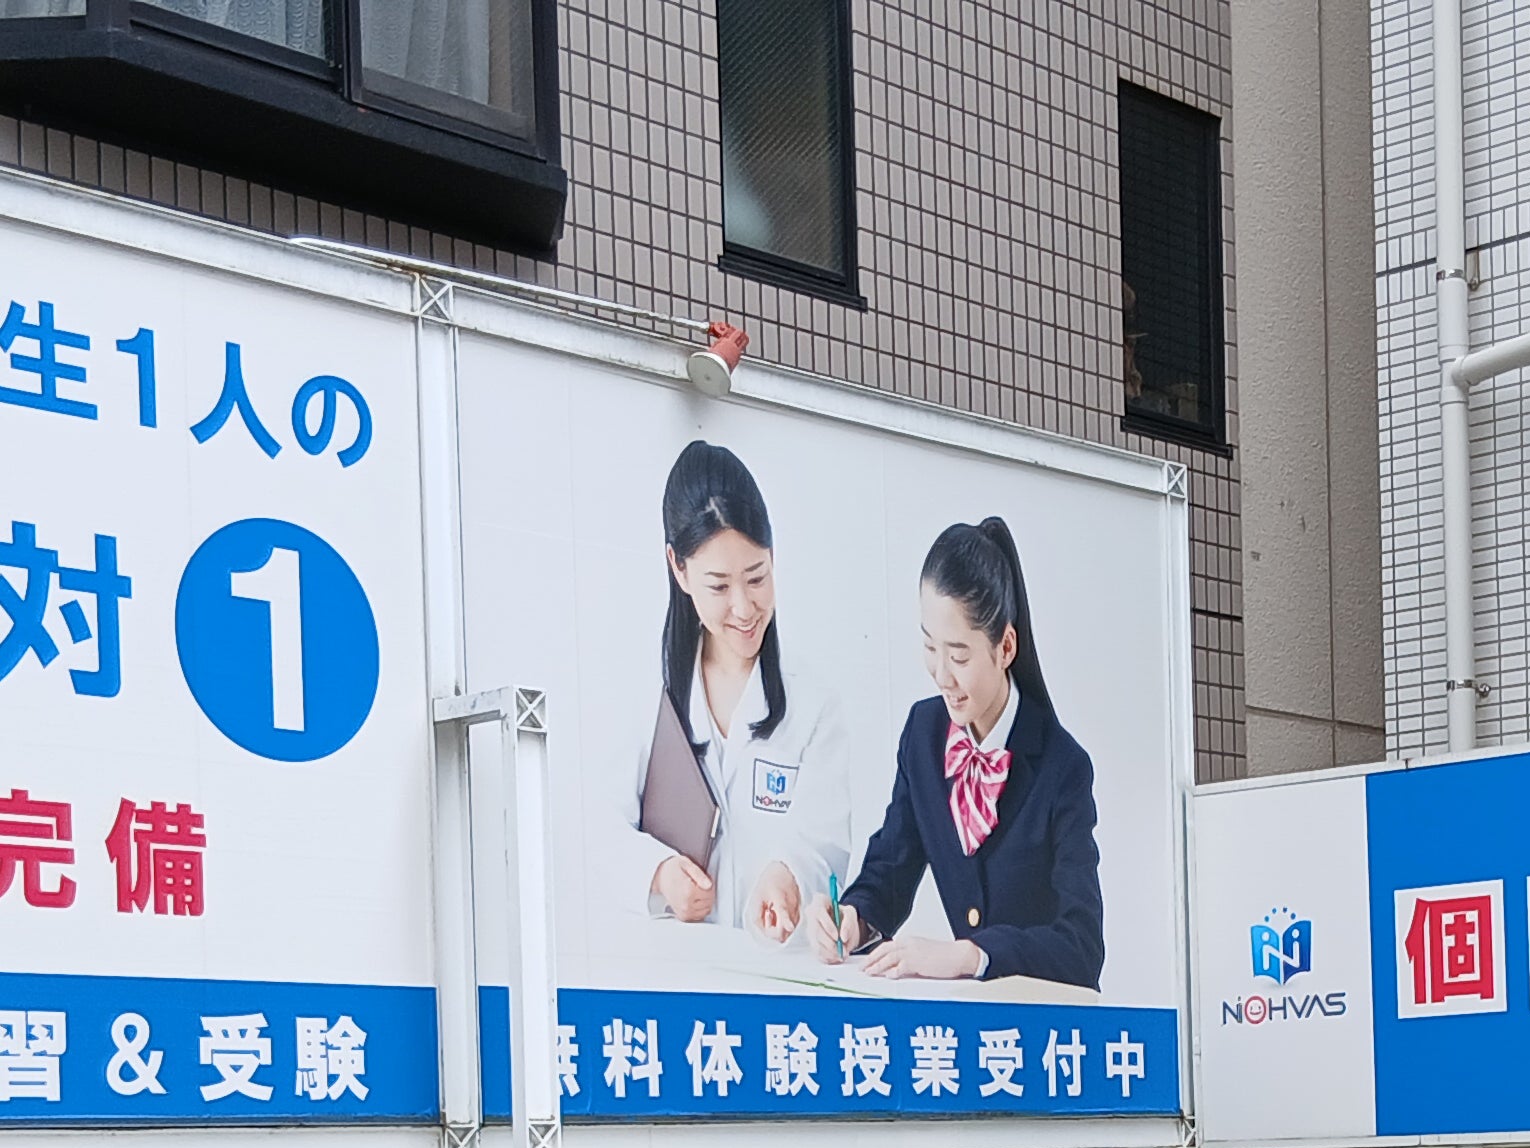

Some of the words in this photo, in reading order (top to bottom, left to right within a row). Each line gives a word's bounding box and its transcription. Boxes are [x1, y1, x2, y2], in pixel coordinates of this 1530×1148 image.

[0, 300, 373, 468] 生1人の
[0, 788, 207, 916] 完備
[0, 1010, 370, 1102] 習&受験
[1221, 990, 1347, 1026] NOHVAS
